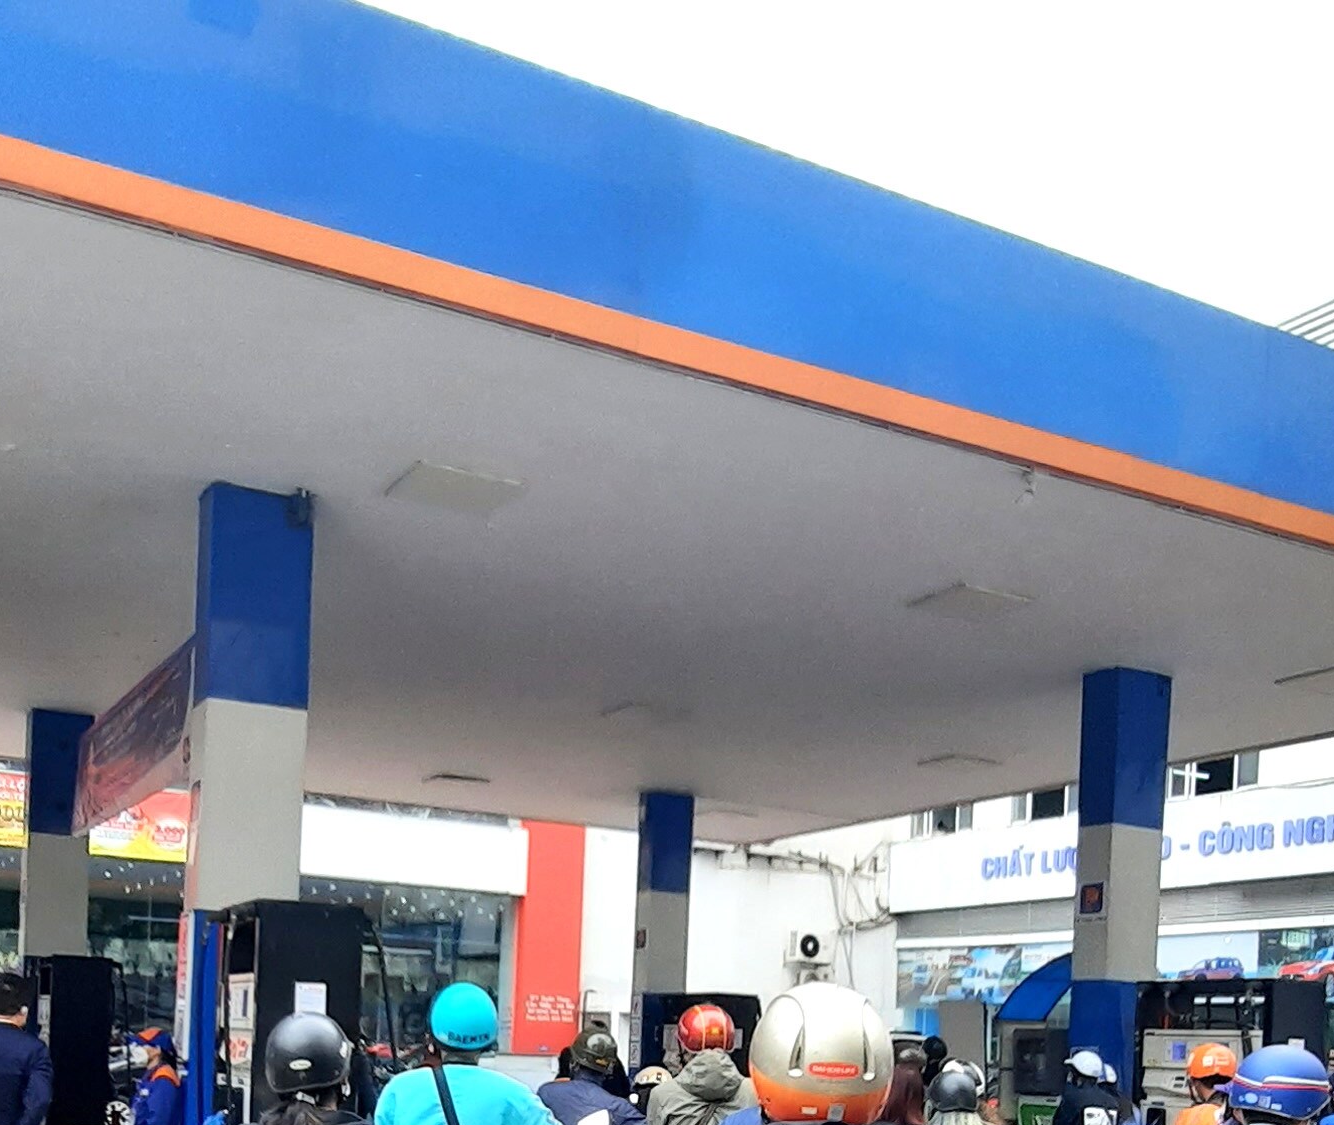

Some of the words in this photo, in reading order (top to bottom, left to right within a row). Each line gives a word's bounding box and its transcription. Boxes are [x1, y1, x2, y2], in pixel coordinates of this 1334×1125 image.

[981, 845, 1035, 880] CHẤT
[1199, 822, 1274, 857] CÔNG
[447, 1031, 492, 1045] BAEMIN
